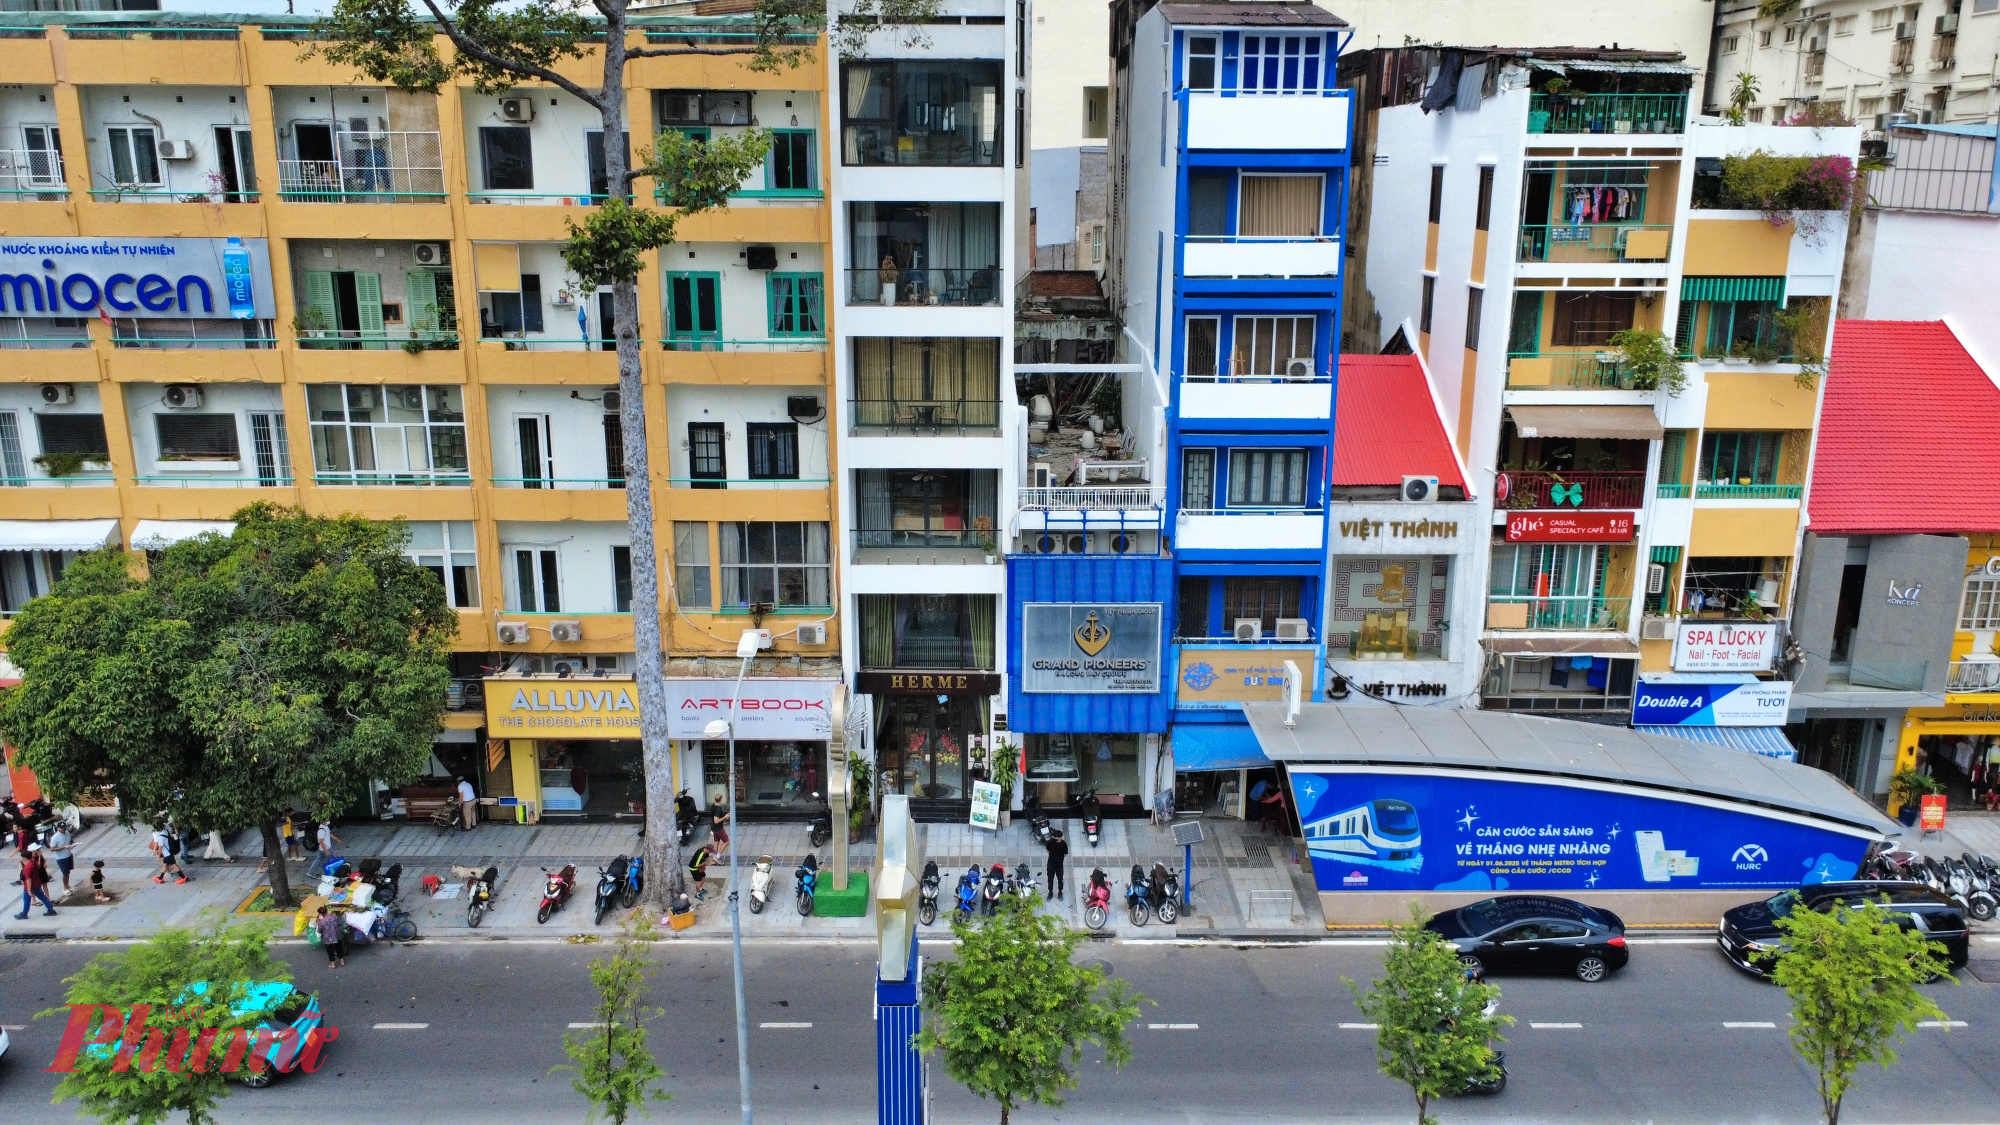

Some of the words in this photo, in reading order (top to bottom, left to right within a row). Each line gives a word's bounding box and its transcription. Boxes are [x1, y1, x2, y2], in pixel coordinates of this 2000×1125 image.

[2, 242, 36, 255] NƯỚC
[39, 242, 89, 255] KHOÁNG
[91, 240, 120, 255] KIỂM
[122, 245, 138, 258] TỰ
[140, 243, 175, 256] NHIÊN
[0, 258, 214, 312] miocen
[232, 258, 247, 301] miocen
[1339, 517, 1383, 541] VIỆT
[1390, 517, 1459, 539] THÀNH
[1510, 517, 1544, 540] ghé
[1587, 526, 1604, 534] CAFÉ
[1618, 519, 1629, 528] 16
[1687, 630, 1714, 646] SPA
[1718, 630, 1767, 646] LUCKY
[1688, 649, 1704, 660] Nail
[1711, 649, 1730, 660] Foot
[1737, 649, 1761, 660] Facial
[1033, 659, 1079, 671] GRAND
[1084, 659, 1146, 671] PIONEERS
[891, 675, 967, 689] HERME
[1267, 675, 1283, 686] BÌN
[1397, 680, 1447, 697] THÀNH
[510, 687, 636, 711] ALLUVIA
[681, 698, 824, 710] ARTBOOK
[1638, 695, 1689, 708] Double
[1690, 696, 1703, 708] A
[1757, 698, 1786, 707] TƯƠI
[499, 717, 523, 727] THE
[527, 717, 602, 727] CHOCOLATE
[605, 717, 640, 727] HOUS
[1476, 826, 1500, 837] CĂN
[1503, 826, 1536, 837] CƯỚC
[1563, 826, 1594, 837] SÀNG
[1455, 842, 1472, 855] VÉ
[1476, 842, 1524, 855] THÁNG
[1528, 844, 1556, 857] NHẸ
[1559, 841, 1611, 855] NHÀNG
